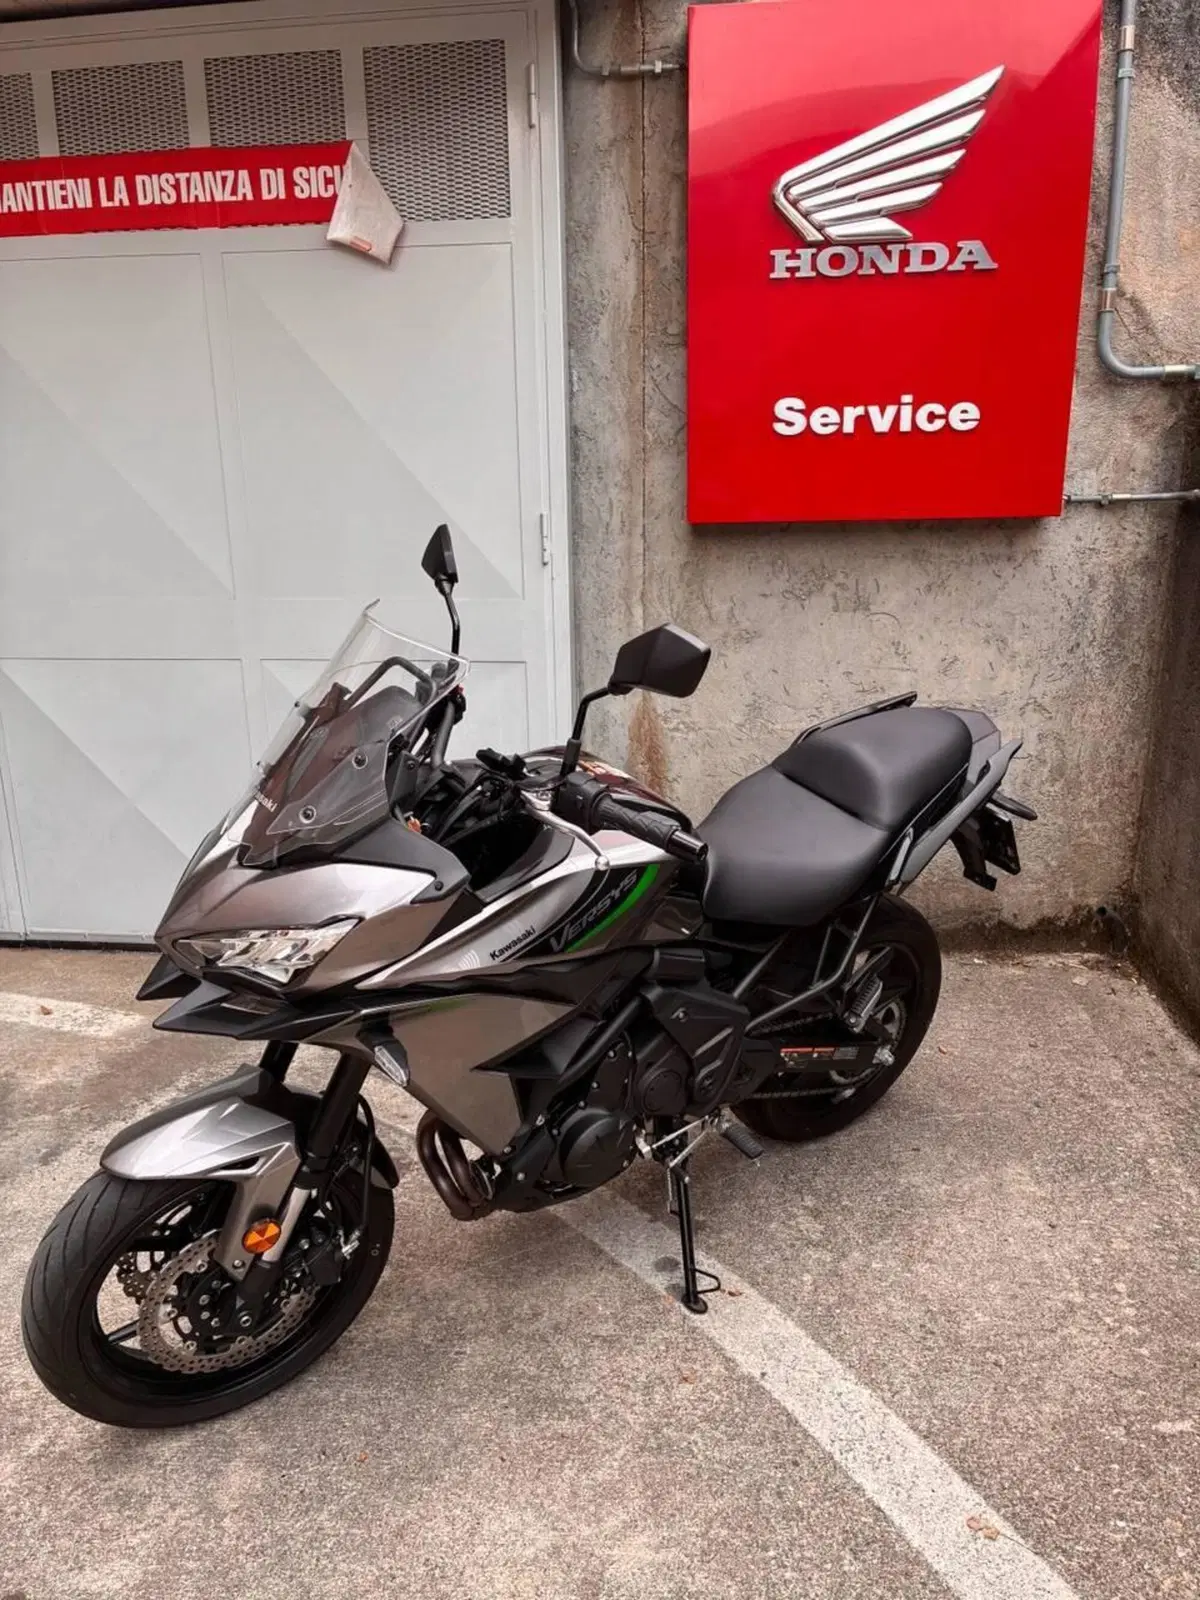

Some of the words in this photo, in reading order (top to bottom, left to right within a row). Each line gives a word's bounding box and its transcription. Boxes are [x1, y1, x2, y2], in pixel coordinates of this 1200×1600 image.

[0, 178, 92, 213] ANTIENI
[97, 176, 131, 208] LA
[135, 169, 255, 206] DISTANZA
[259, 167, 286, 201] DI
[769, 239, 998, 279] HONDA
[772, 394, 981, 436] Service
[489, 925, 536, 960] Kawasaki
